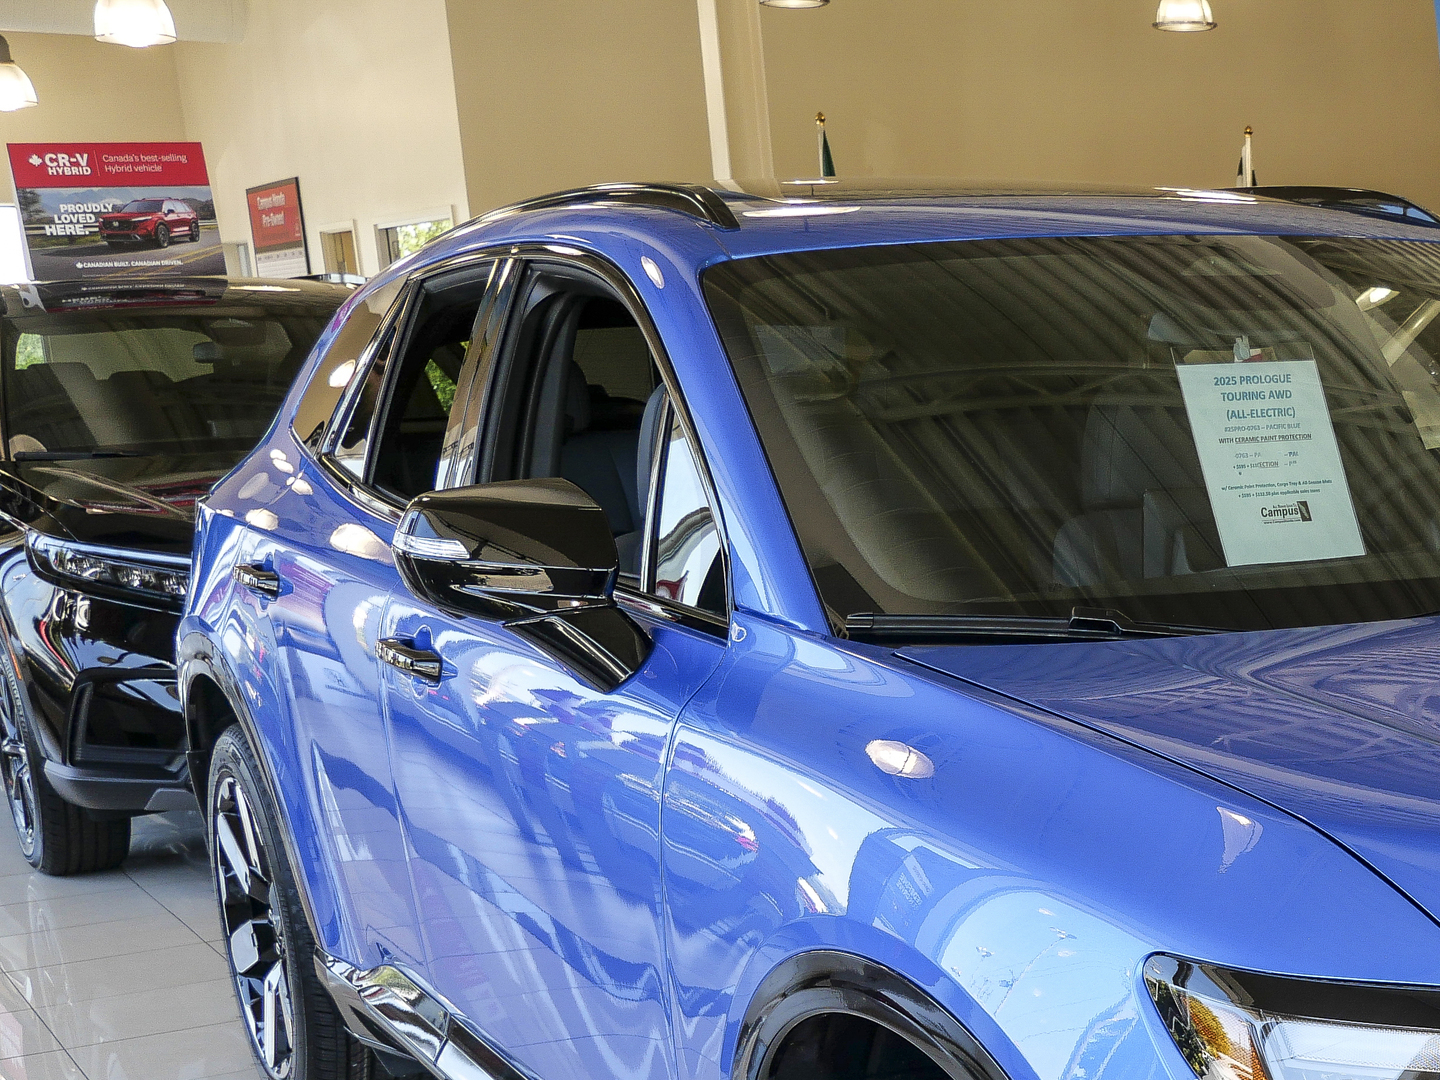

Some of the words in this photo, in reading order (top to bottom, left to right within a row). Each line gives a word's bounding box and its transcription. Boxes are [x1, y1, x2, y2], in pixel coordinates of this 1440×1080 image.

[44, 153, 89, 167] CR-V
[102, 154, 138, 163] Canada's
[140, 153, 188, 163] best-selling
[48, 167, 92, 175] HYBRID
[104, 164, 133, 175] Hybrid
[59, 203, 114, 213] PROUDLY
[54, 214, 96, 224] LOVED
[44, 224, 90, 236] HERE.
[1214, 375, 1237, 386] 2025
[1239, 374, 1292, 385] PROLOGUE
[1221, 391, 1266, 401] TOURING
[1268, 389, 1292, 400] AWD
[1226, 407, 1296, 421] (ALL-ELECTRIC)
[1278, 433, 1312, 441] PROTECTION
[1260, 506, 1299, 518] Campus
